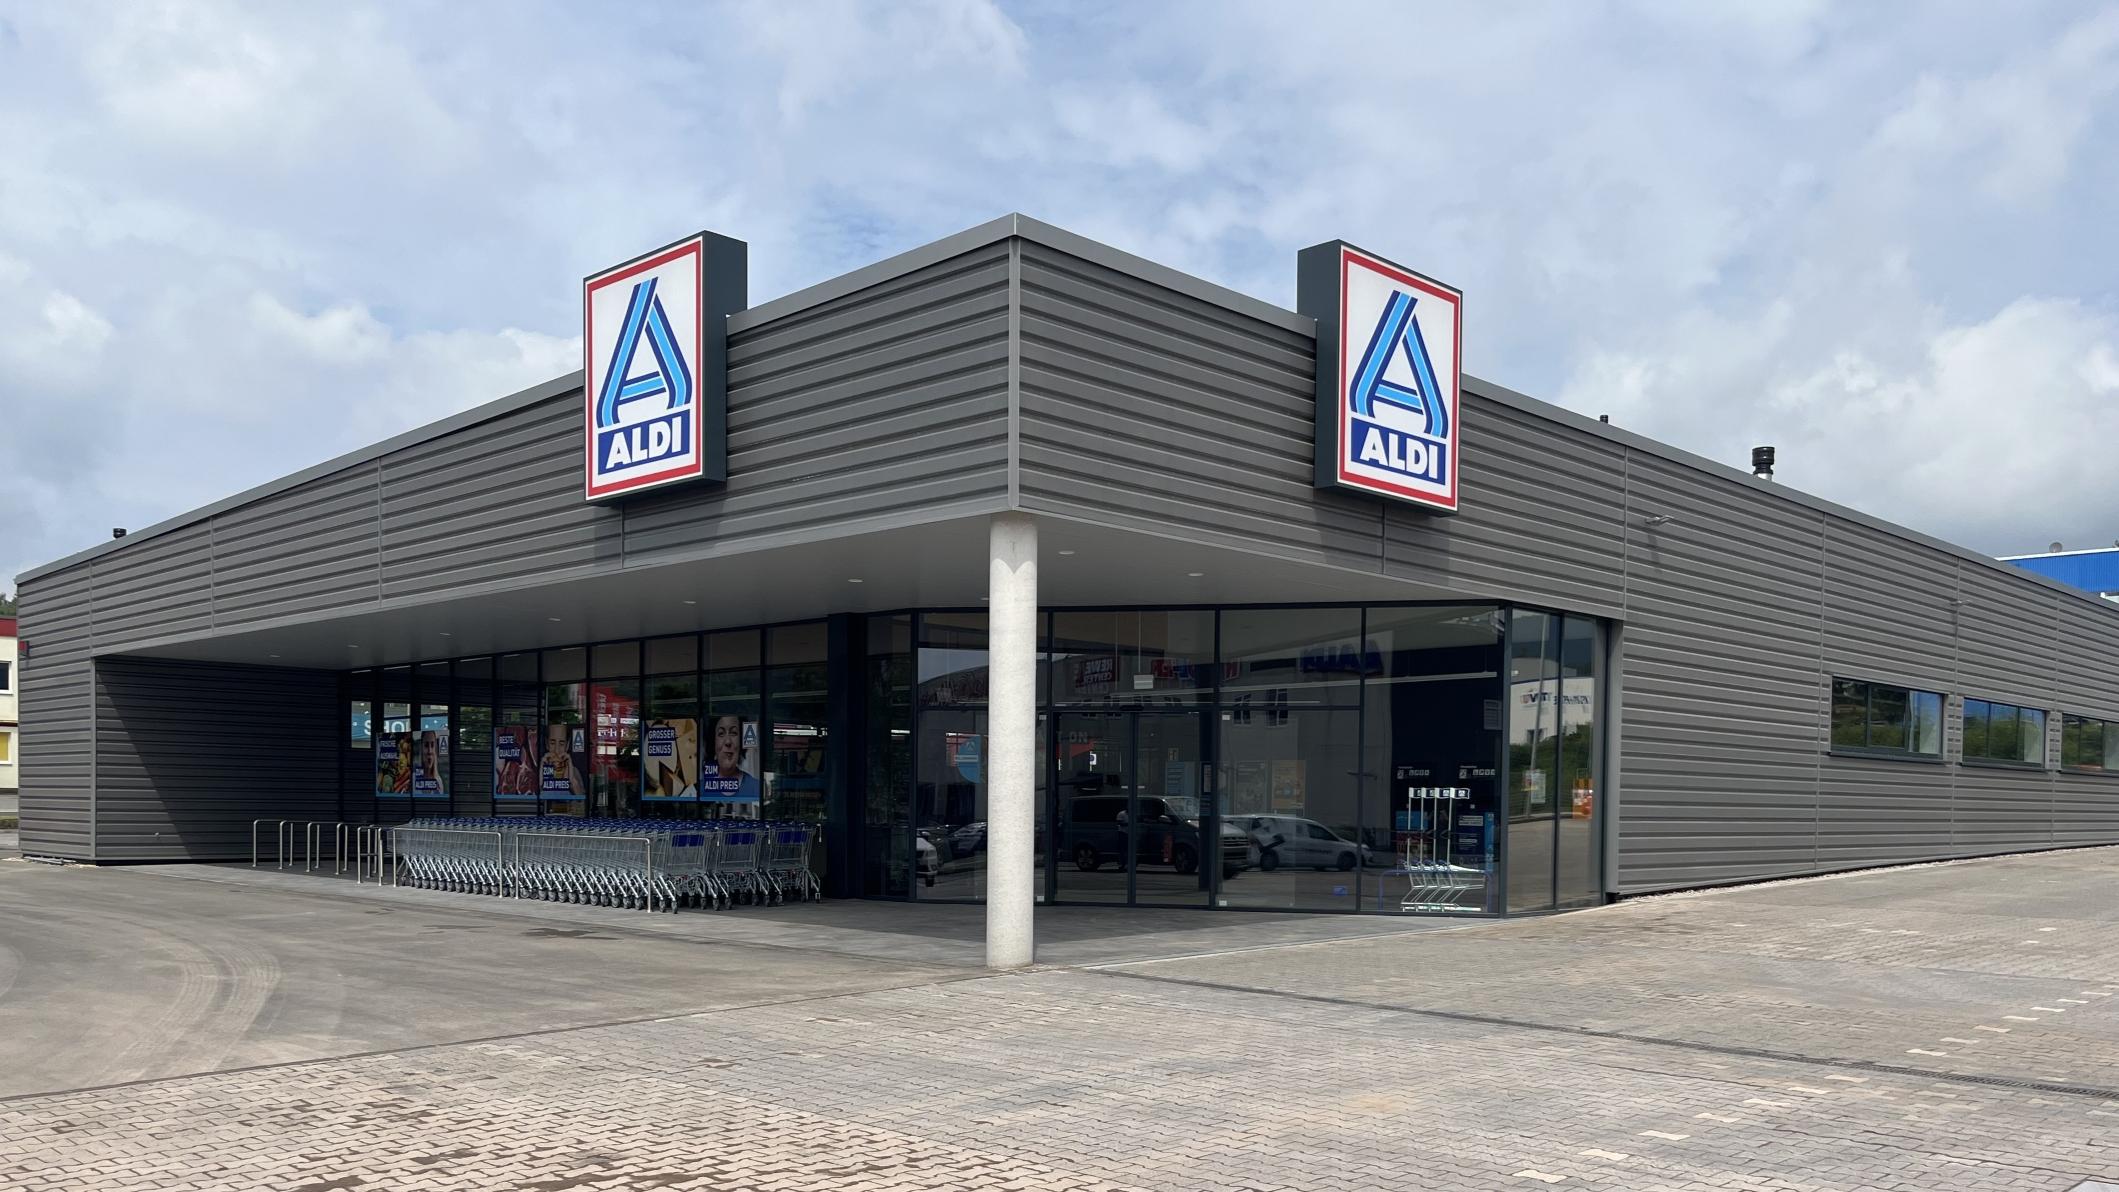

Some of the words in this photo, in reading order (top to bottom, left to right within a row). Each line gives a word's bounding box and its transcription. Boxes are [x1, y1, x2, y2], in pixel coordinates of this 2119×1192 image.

[605, 416, 682, 469] ALDI
[1359, 427, 1440, 480] ALDI
[648, 729, 675, 739] GROSSER
[648, 744, 671, 754] GENUSS
[544, 767, 553, 775] ZUM
[704, 765, 718, 775] ZUM
[543, 780, 555, 789] ALDI
[555, 780, 570, 789] PREIS
[704, 780, 719, 790] ALDI
[720, 780, 739, 790] PREIS
